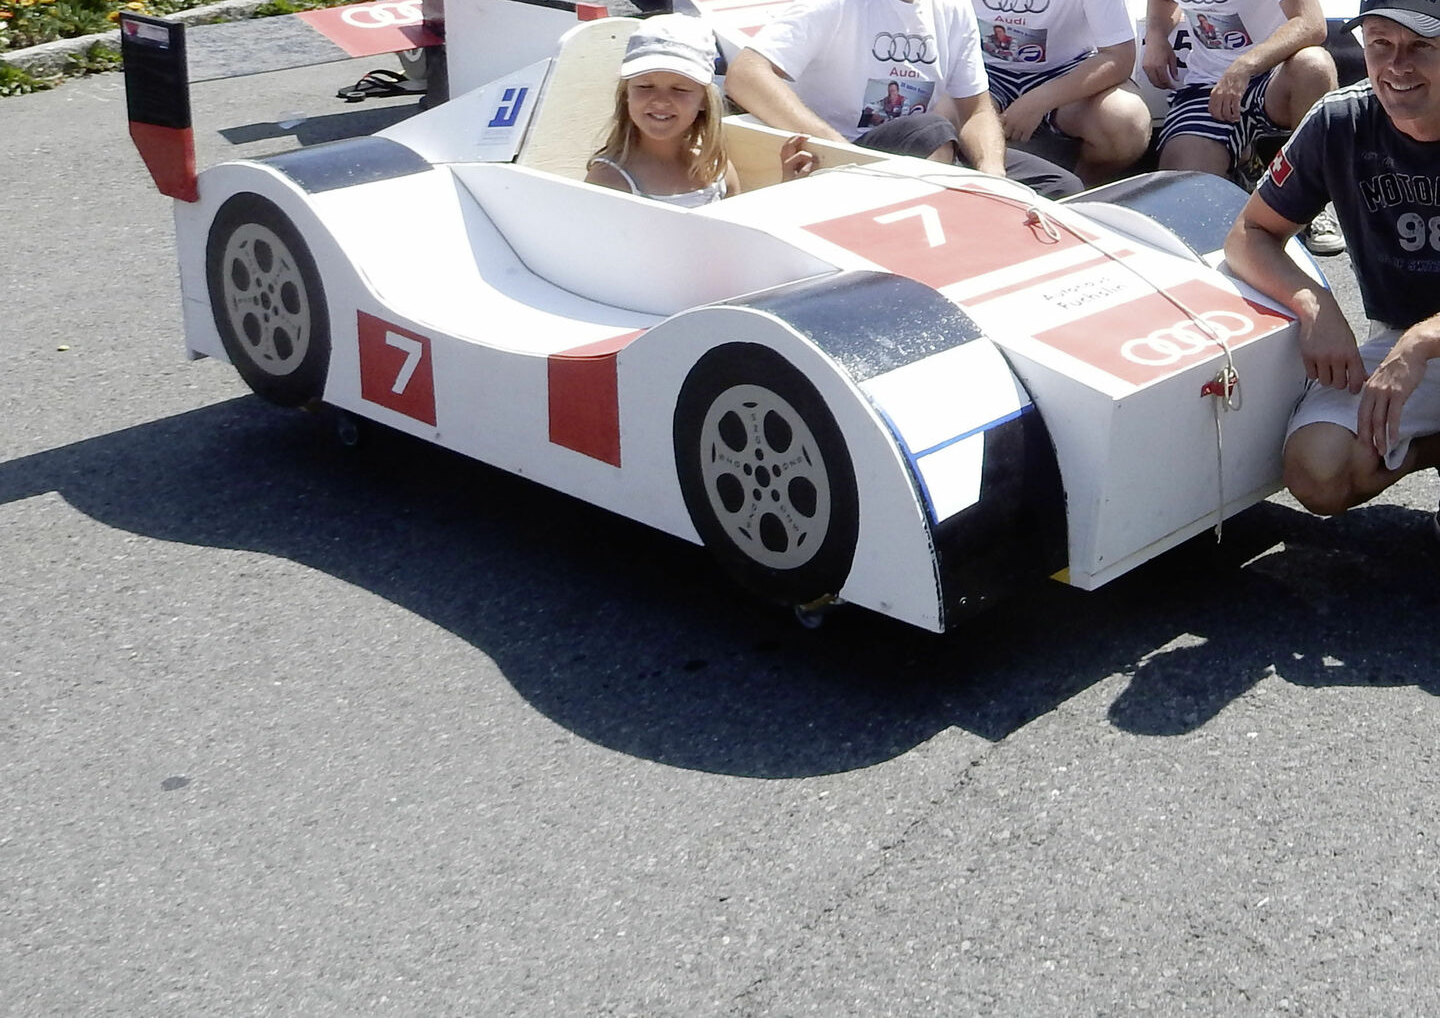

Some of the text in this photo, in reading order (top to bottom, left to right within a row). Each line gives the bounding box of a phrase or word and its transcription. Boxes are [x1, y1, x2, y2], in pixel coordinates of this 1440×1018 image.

[994, 15, 1026, 26] Audi
[889, 66, 921, 78] Audi
[872, 203, 947, 248] 7
[385, 330, 423, 395] 7
